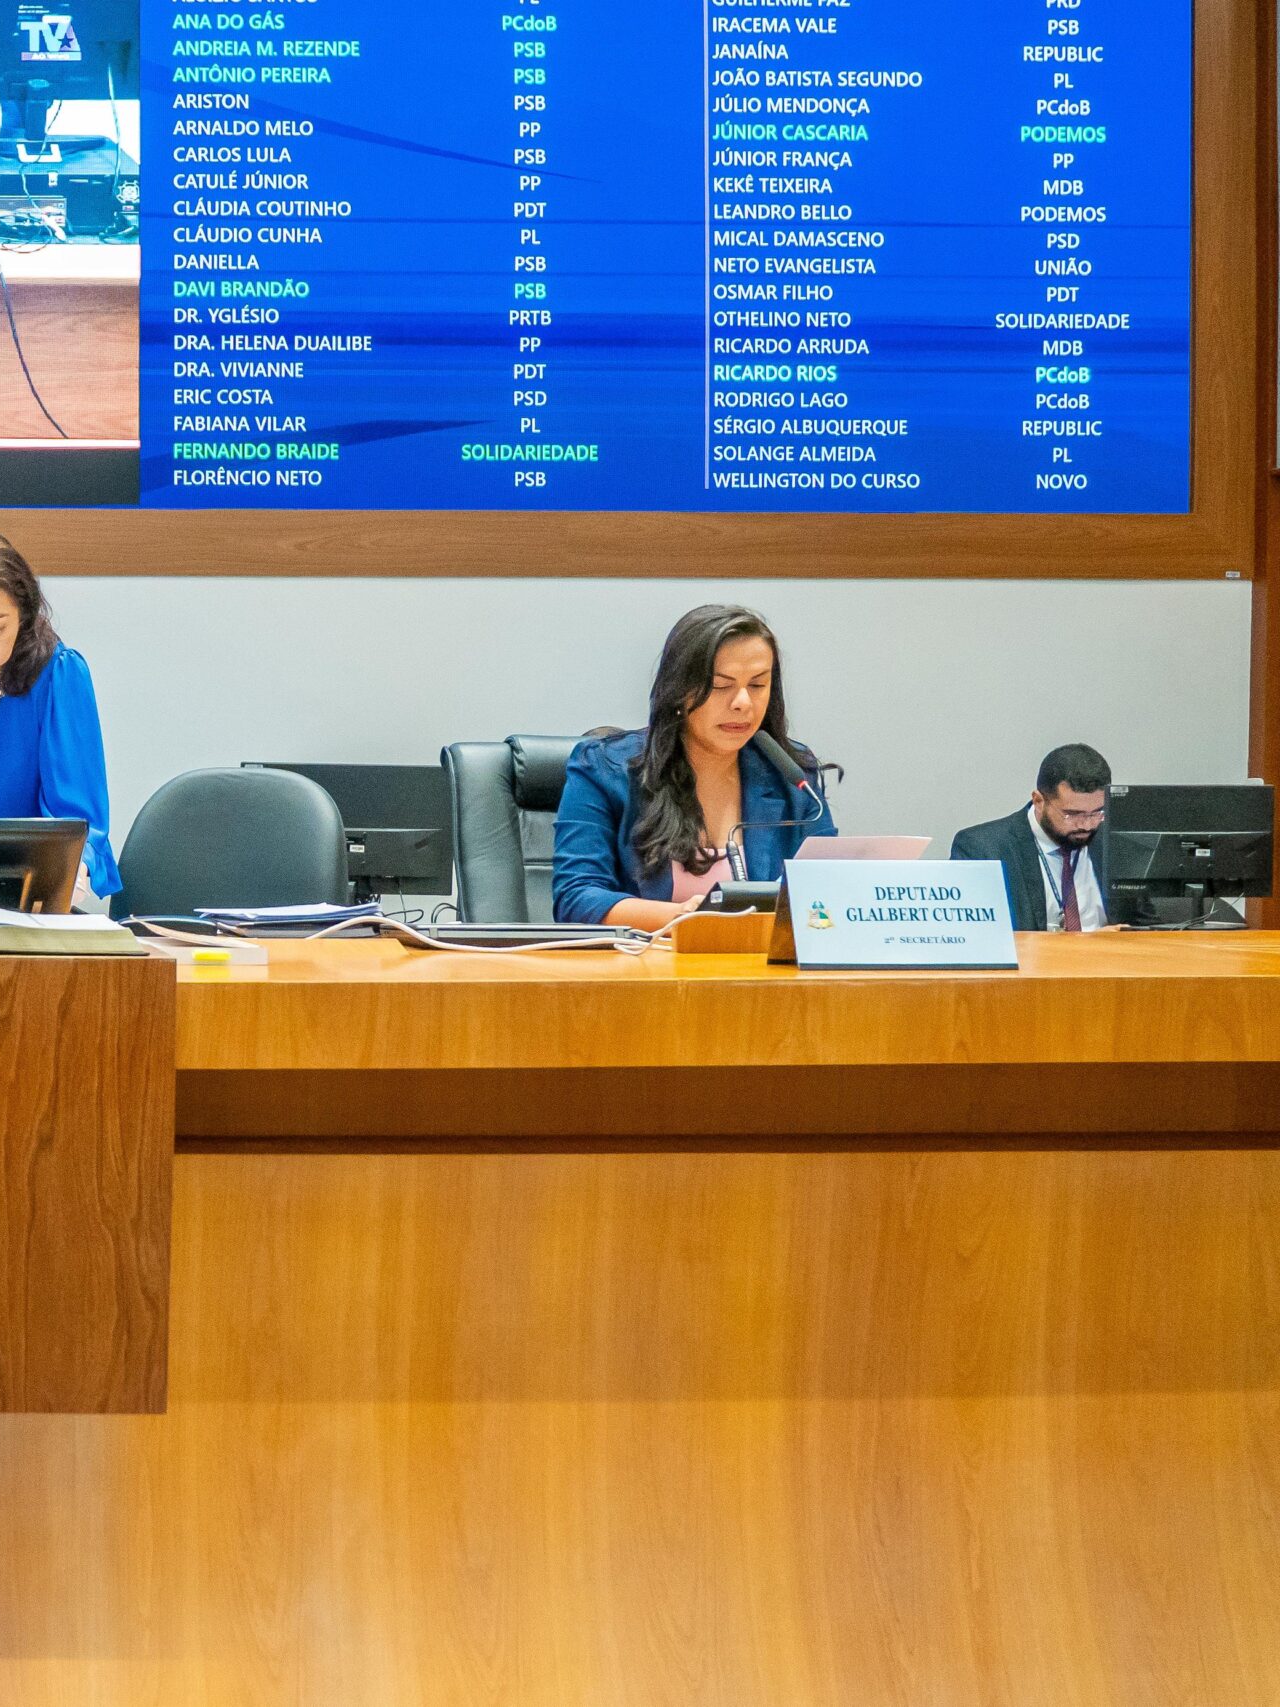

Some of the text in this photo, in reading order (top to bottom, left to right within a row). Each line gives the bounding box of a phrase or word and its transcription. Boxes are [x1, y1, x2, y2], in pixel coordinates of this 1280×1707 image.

[172, 9, 285, 31] ANA DO GÁS
[502, 14, 558, 32] PCdoB
[712, 16, 837, 34] IRACEMA VALE
[1047, 19, 1080, 36] PSB
[172, 40, 361, 57] ANDREIA M. REZENDE
[513, 41, 546, 59] PSB
[711, 40, 789, 60] JANAÍNA
[1023, 45, 1104, 63] REPUBLIC
[172, 63, 332, 84] ANTÔNIO PEREIRA
[513, 68, 547, 85] PSB
[711, 67, 923, 88] JOÃO BATISTA SEGUNDO
[1053, 72, 1074, 89] PL
[172, 93, 250, 110] ARISTON
[514, 94, 546, 112] PSB
[712, 93, 871, 117] JÚLIO MENDONÇA
[1036, 98, 1091, 116] PCdoB
[172, 120, 314, 136] ARNALDO MELO
[519, 121, 541, 138] PP
[712, 120, 869, 142] JÚNIOR CASCARIA
[1020, 125, 1107, 144] PODEMOS
[173, 146, 292, 163] CARLOS LULA
[514, 148, 547, 165] PSB
[712, 146, 853, 171] JÚNIOR FRANÇA
[1053, 152, 1075, 169] PP
[173, 169, 309, 190] CATULÉ JÚNIOR
[519, 175, 542, 191] PP
[713, 173, 833, 194] KEKÊ TEIXEIRA
[1043, 179, 1084, 196] MDB
[173, 196, 352, 217] CLÁUDIA COUTINHO
[513, 202, 547, 219] PDT
[713, 203, 852, 221] LEANDRO BELLO
[1020, 206, 1107, 223] PODEMOS
[173, 223, 323, 244] CLÁUDIO CUNHA
[520, 229, 541, 245] PL
[714, 230, 885, 248] MICAL DAMASCENO
[1046, 232, 1080, 249] PSD
[173, 254, 260, 270] DANIELLA
[514, 255, 547, 272] PSB
[714, 257, 877, 275] NETO EVANGELISTA
[1034, 257, 1092, 276] UNIÃO
[173, 278, 310, 298] DAVI BRANDÃO
[514, 282, 547, 300] PSB
[713, 284, 834, 301] OSMAR FILHO
[1046, 286, 1080, 302] PDT
[173, 304, 280, 324] DR. YGLÉSIO
[509, 309, 552, 326] PRTB
[713, 310, 852, 328] OTHELINO NETO
[995, 313, 1130, 329] SOLIDARIEDADE
[174, 334, 372, 352] DRA. HELENA DUAILIBE
[519, 336, 541, 353] PP
[714, 337, 870, 355] RICARDO ARRUDA
[1042, 340, 1083, 356] MDB
[173, 361, 304, 378] DRA. VIVIANNE
[513, 363, 547, 380] PDT
[713, 364, 838, 383] RICARDO RIOS
[1035, 365, 1091, 384] PCdoB
[173, 388, 274, 405] ERIC COSTA
[513, 390, 547, 407] PSD
[714, 391, 848, 408] RODRIGO LAGO
[1036, 392, 1090, 410] PCdoB
[173, 415, 307, 432] FABIANA VILAR
[520, 417, 541, 433] PL
[713, 414, 908, 437] SÉRGIO ALBUQUERQUE
[1022, 420, 1103, 436] REPUBLIC
[173, 442, 339, 460] FERNANDO BRAIDE
[461, 443, 599, 462] SOLIDARIEDADE
[713, 445, 877, 462] SOLANGE ALMEIDA
[1052, 447, 1073, 463] PL
[173, 466, 323, 487] FLORÊNCIO NETO
[514, 471, 547, 487] PSB
[712, 472, 921, 489] WELLINGTON DO CURSO
[1036, 473, 1088, 490] NOVO
[874, 886, 963, 901] DEPUTADO
[846, 907, 997, 923] GLALBERT CUTRIM
[899, 935, 966, 944] SECRETÁRIO
